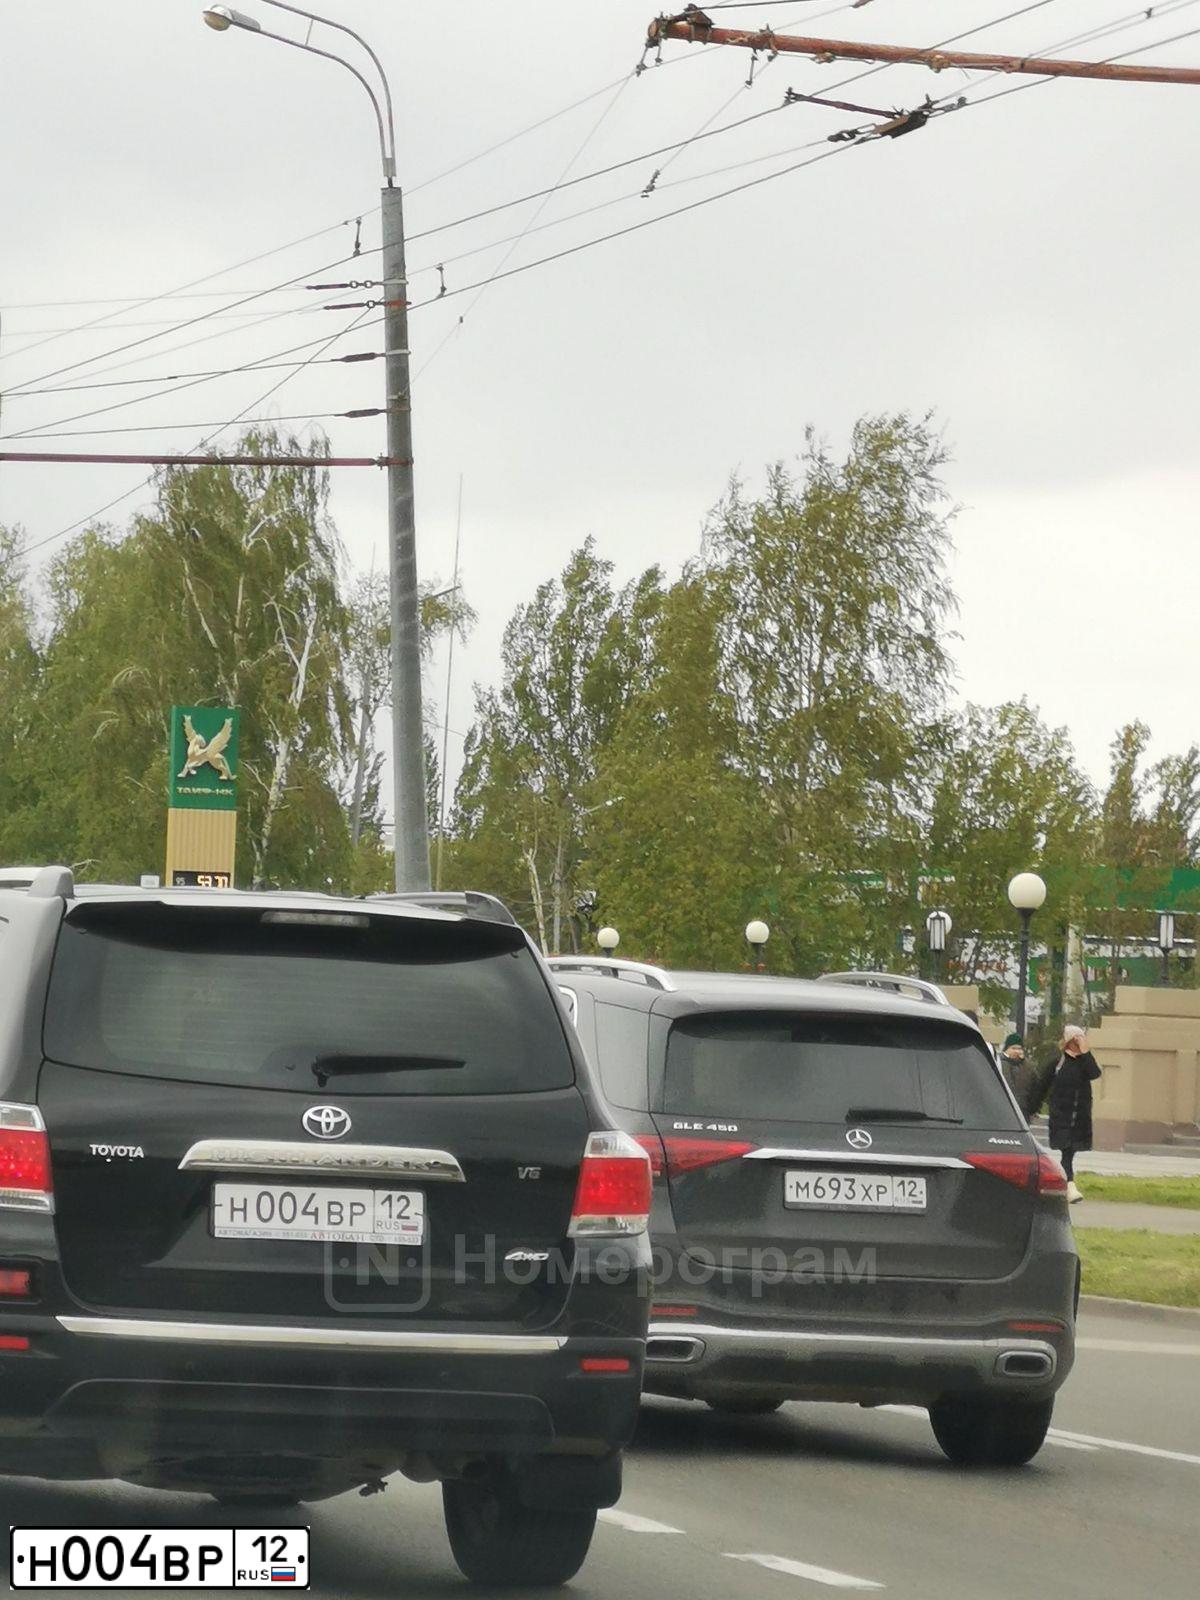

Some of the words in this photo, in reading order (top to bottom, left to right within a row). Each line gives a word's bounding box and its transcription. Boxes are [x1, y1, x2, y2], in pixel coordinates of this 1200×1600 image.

[673, 1122, 703, 1131] GLE
[706, 1123, 738, 1132] 450
[89, 1144, 145, 1158] TOYOTA
[796, 1177, 887, 1202] М693ХР
[897, 1180, 917, 1197] 12
[229, 1191, 366, 1226] Н004ВР
[381, 1194, 411, 1219] 12
[376, 1220, 400, 1230] RUS
